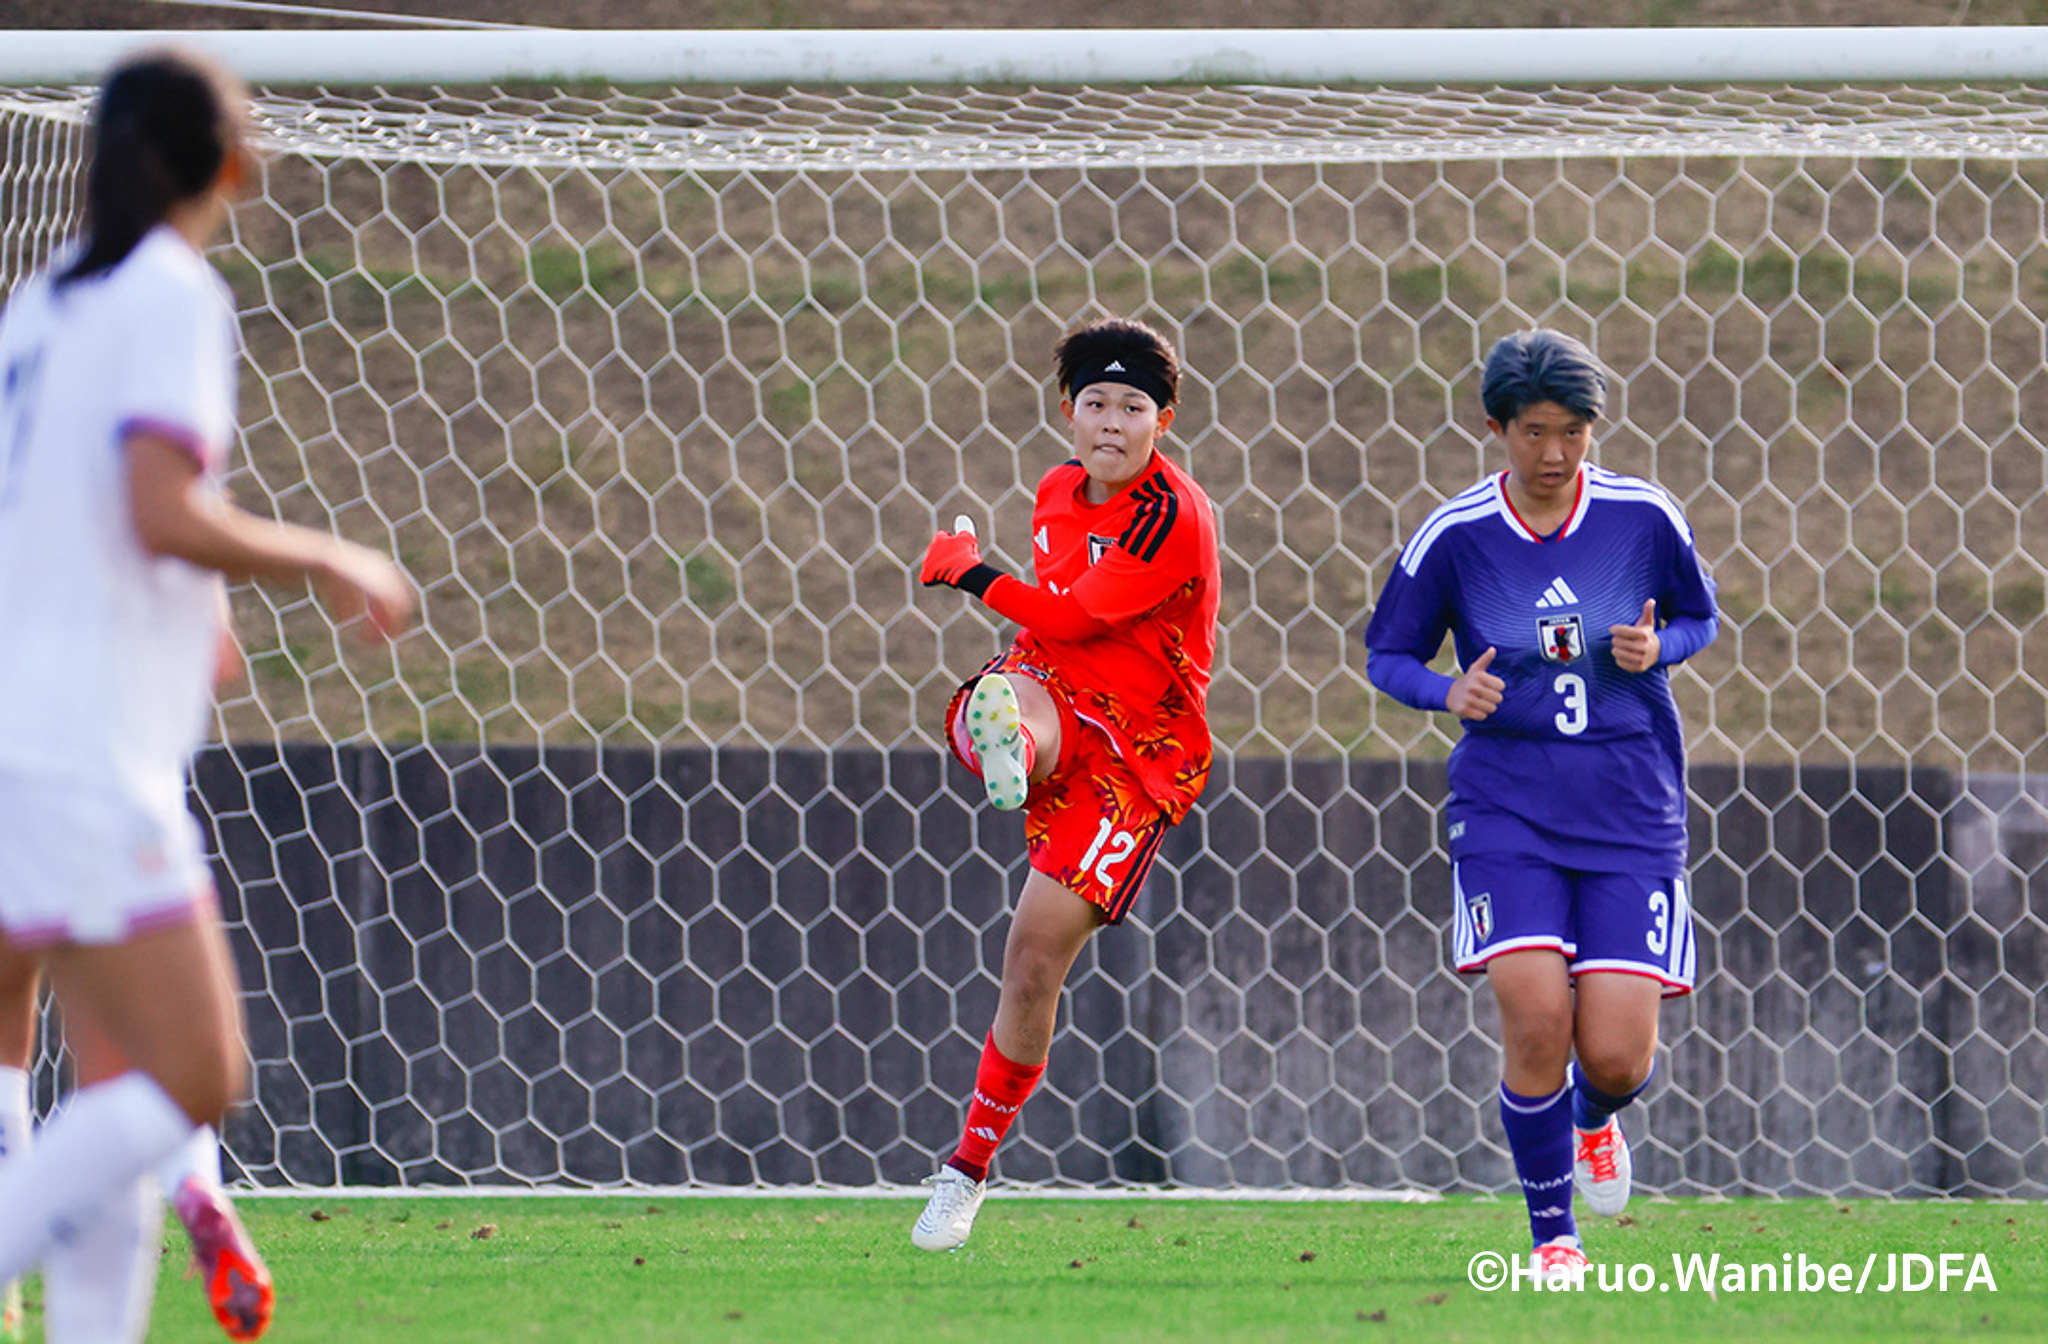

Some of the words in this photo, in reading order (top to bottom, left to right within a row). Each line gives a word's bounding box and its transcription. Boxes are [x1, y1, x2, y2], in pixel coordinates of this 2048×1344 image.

[1553, 672, 1588, 736] 3
[1079, 816, 1136, 888] 12
[1646, 891, 1669, 956] 3
